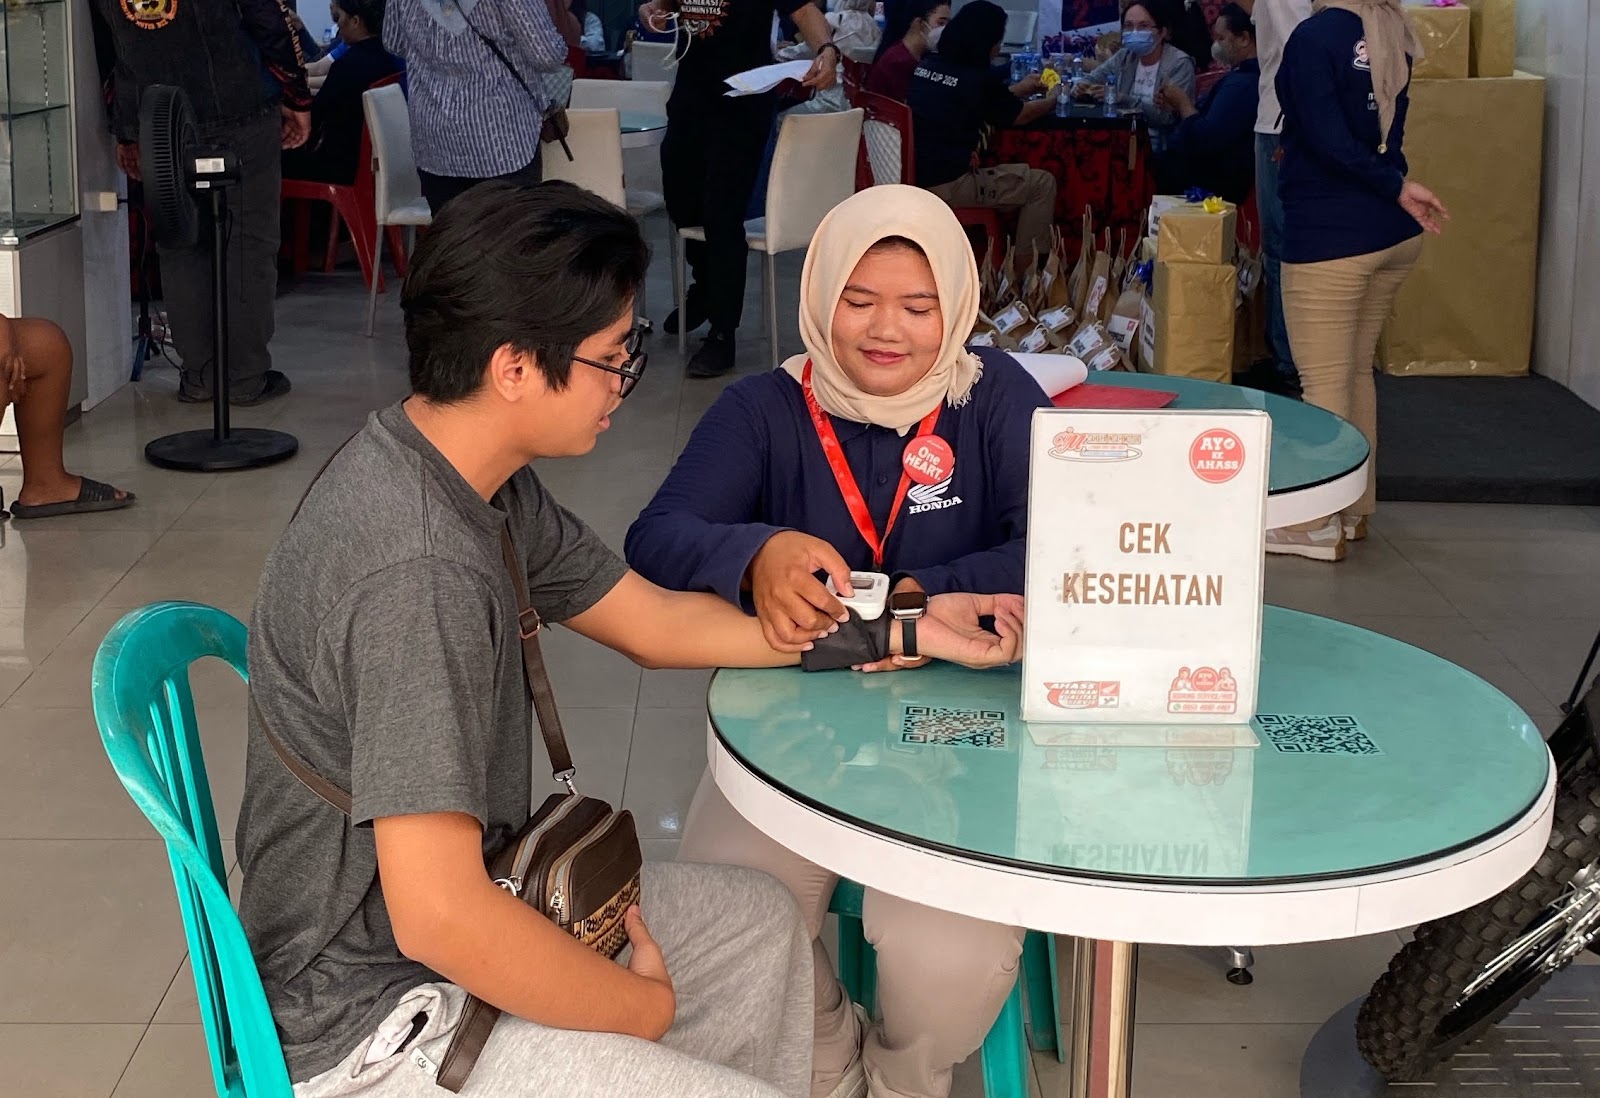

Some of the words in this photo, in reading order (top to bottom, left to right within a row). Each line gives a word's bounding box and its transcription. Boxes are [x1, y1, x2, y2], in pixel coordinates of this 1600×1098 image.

[917, 446, 941, 466] One
[1196, 460, 1239, 470] AHASS
[908, 496, 963, 515] HONDA
[1119, 522, 1171, 554] CEK
[1062, 572, 1223, 606] KESEHATAN
